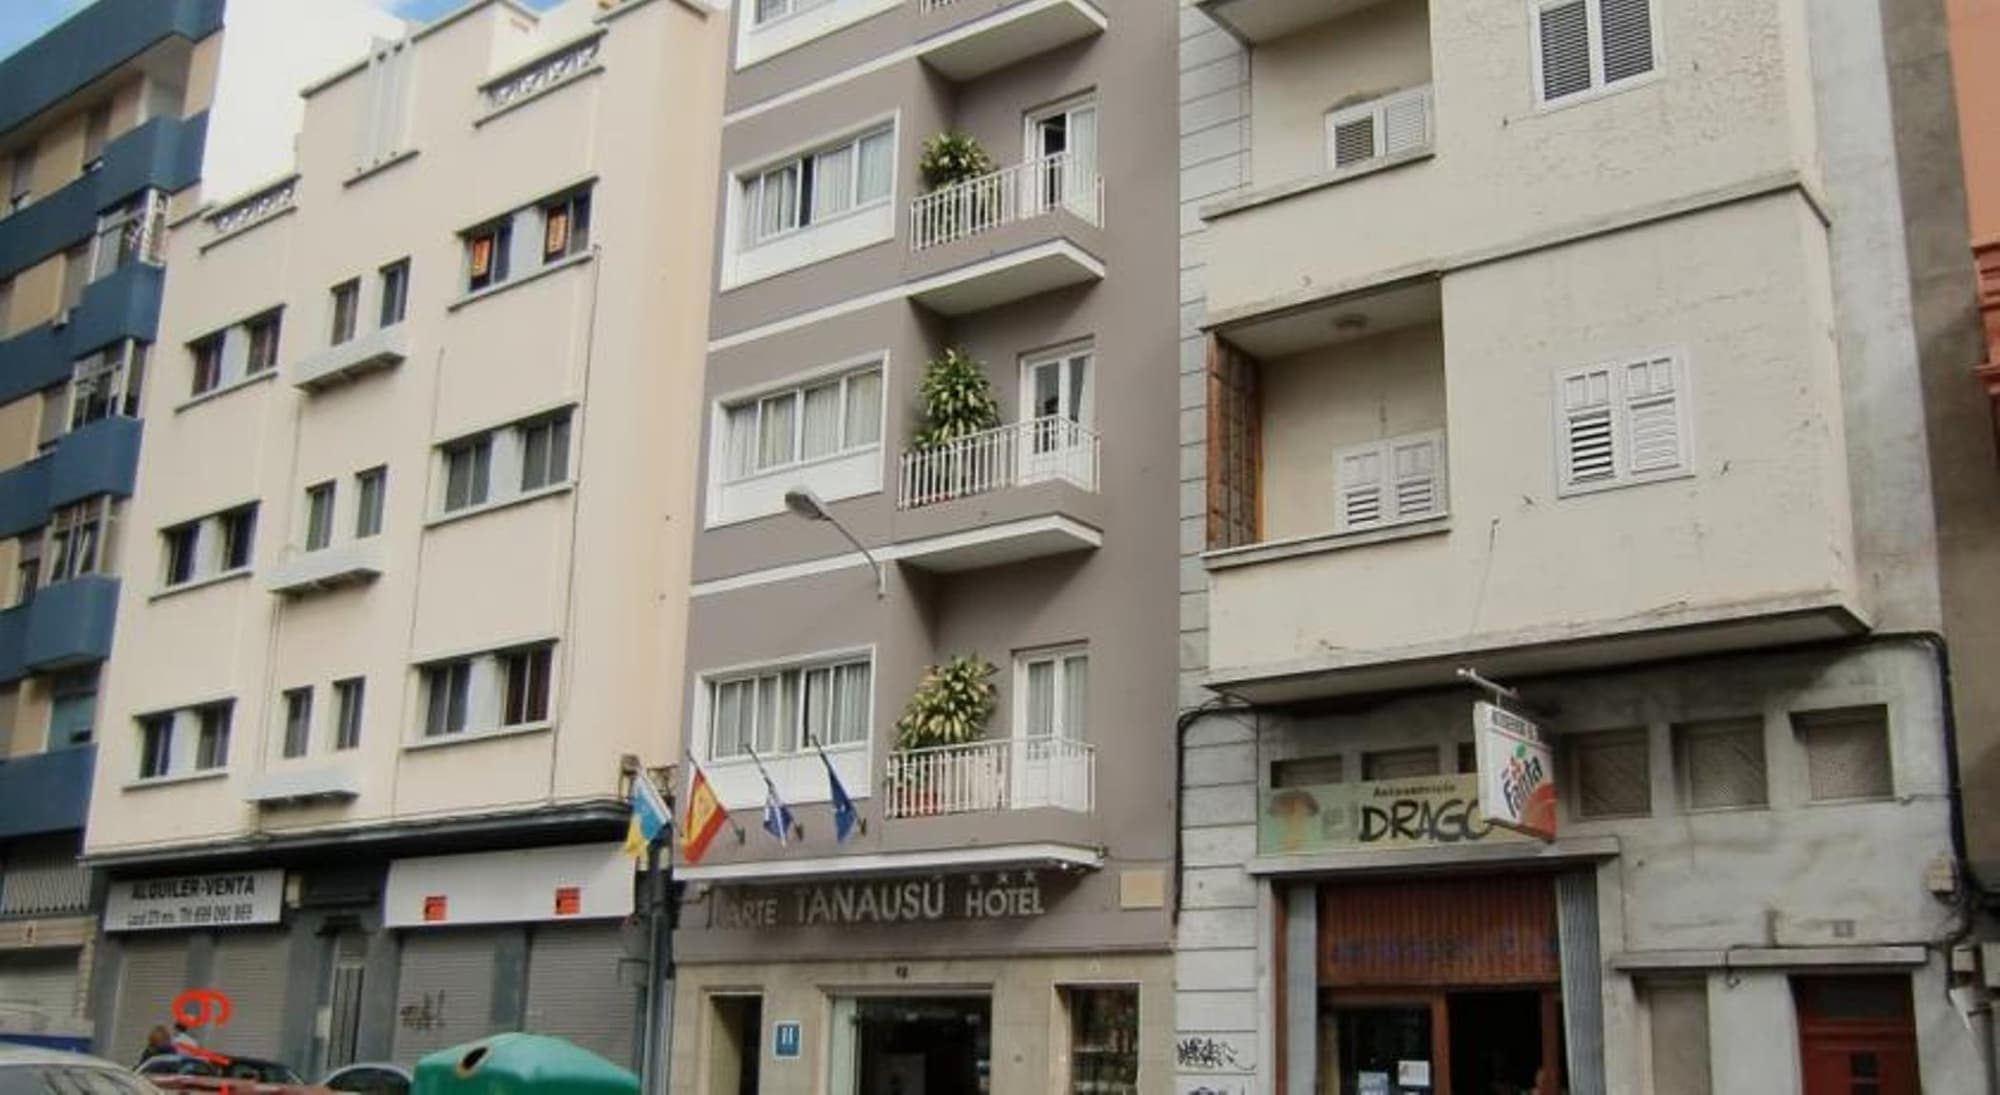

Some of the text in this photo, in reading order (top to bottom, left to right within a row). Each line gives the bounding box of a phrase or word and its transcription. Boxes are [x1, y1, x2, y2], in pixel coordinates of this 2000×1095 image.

[1501, 757, 1543, 819] Fanta
[131, 875, 256, 900] ALQUILER-VENTA
[797, 876, 945, 925] TANAUSÚ
[965, 885, 1045, 918] HOTEL
